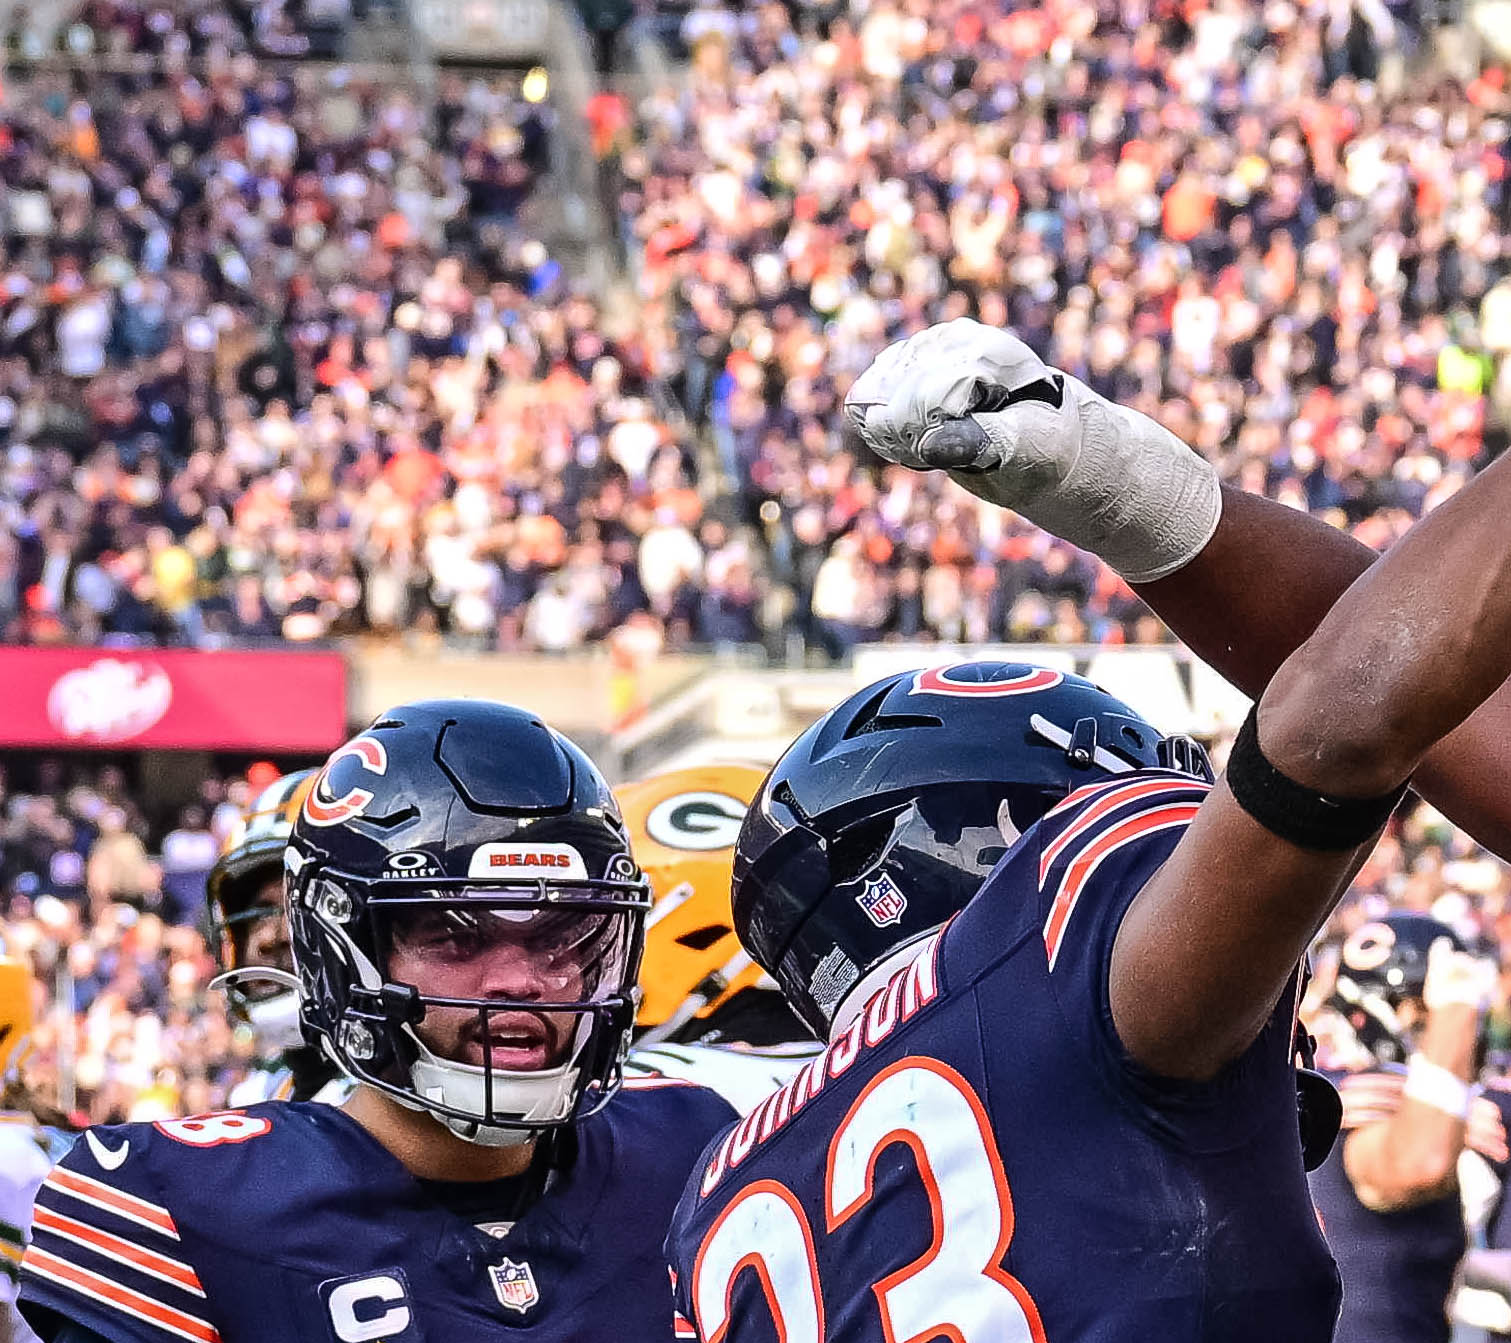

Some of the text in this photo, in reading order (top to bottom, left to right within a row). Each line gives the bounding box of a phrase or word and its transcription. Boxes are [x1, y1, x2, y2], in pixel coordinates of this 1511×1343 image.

[303, 736, 388, 828] C
[489, 853, 571, 868] BEARS
[329, 1276, 412, 1343] C
